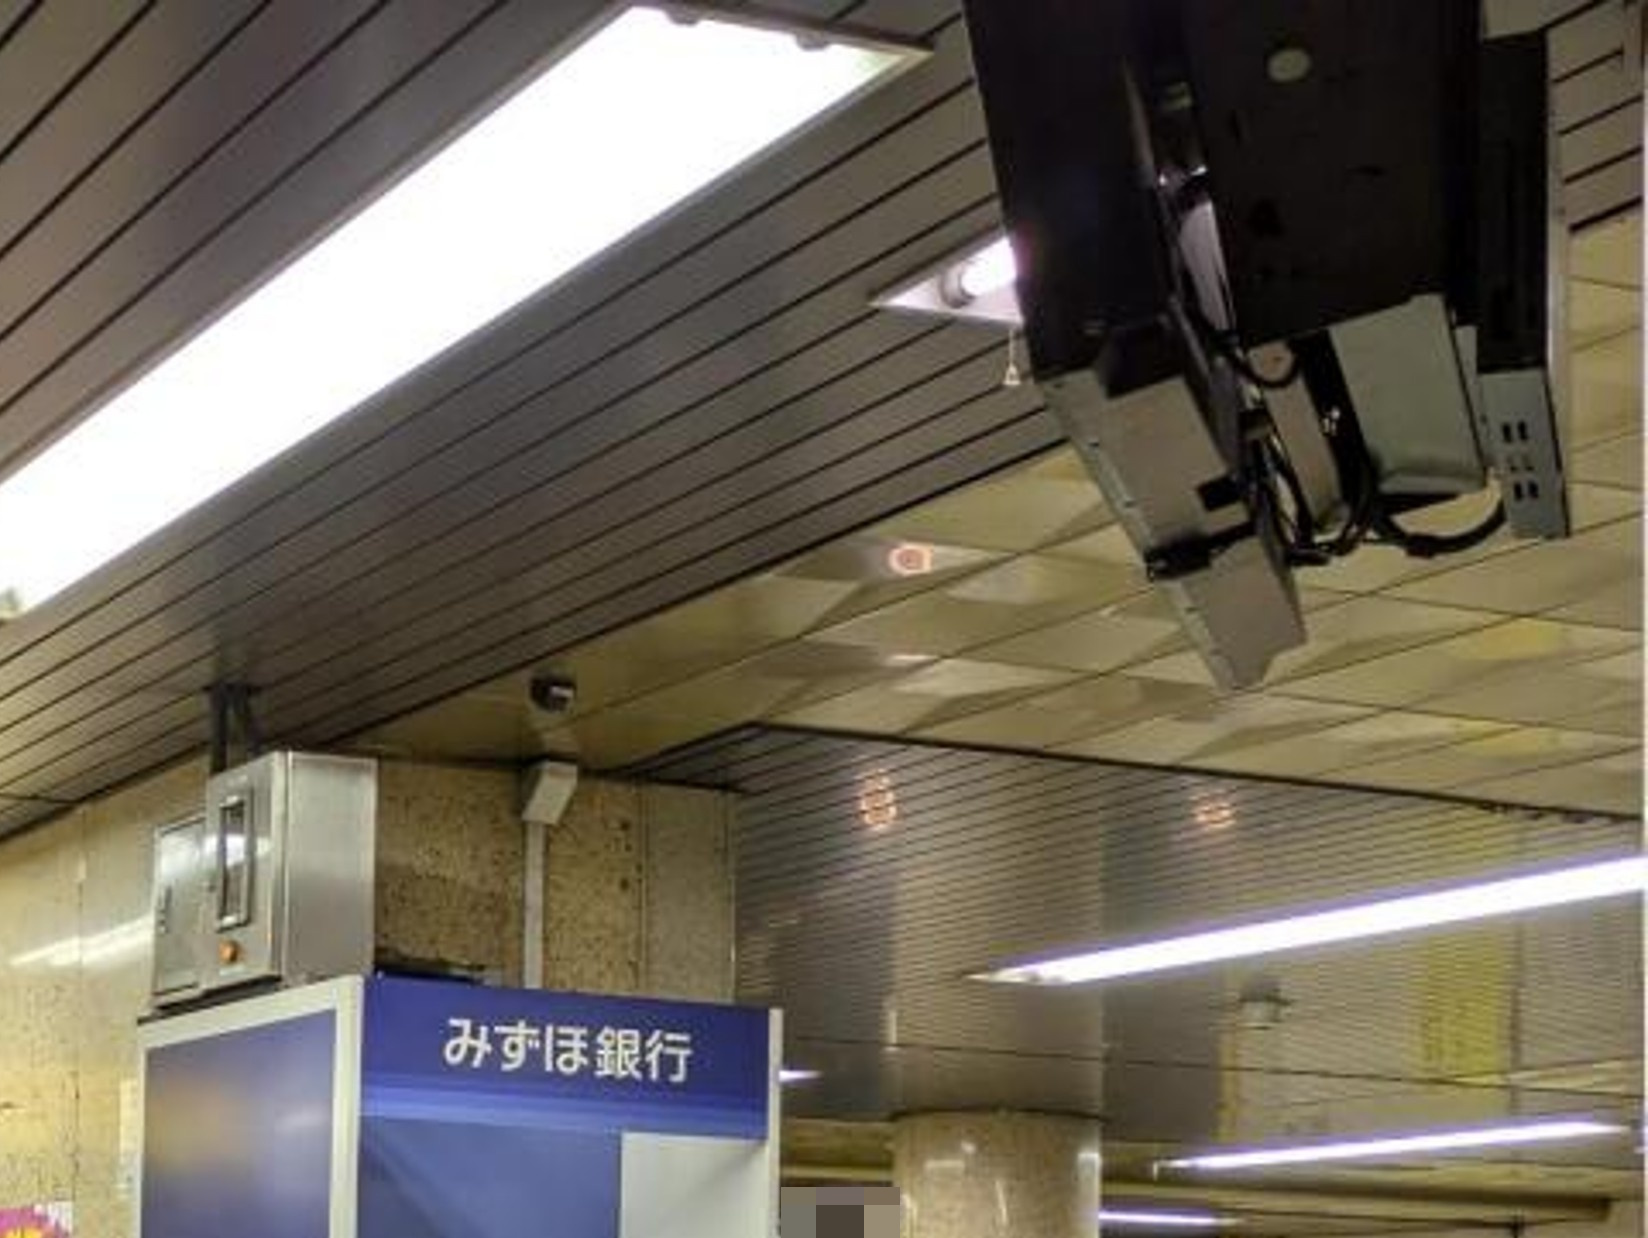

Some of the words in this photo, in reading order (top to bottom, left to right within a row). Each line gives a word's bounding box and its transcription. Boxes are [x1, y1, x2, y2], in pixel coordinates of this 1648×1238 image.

[443, 1017, 694, 1084] みずほ銀行
